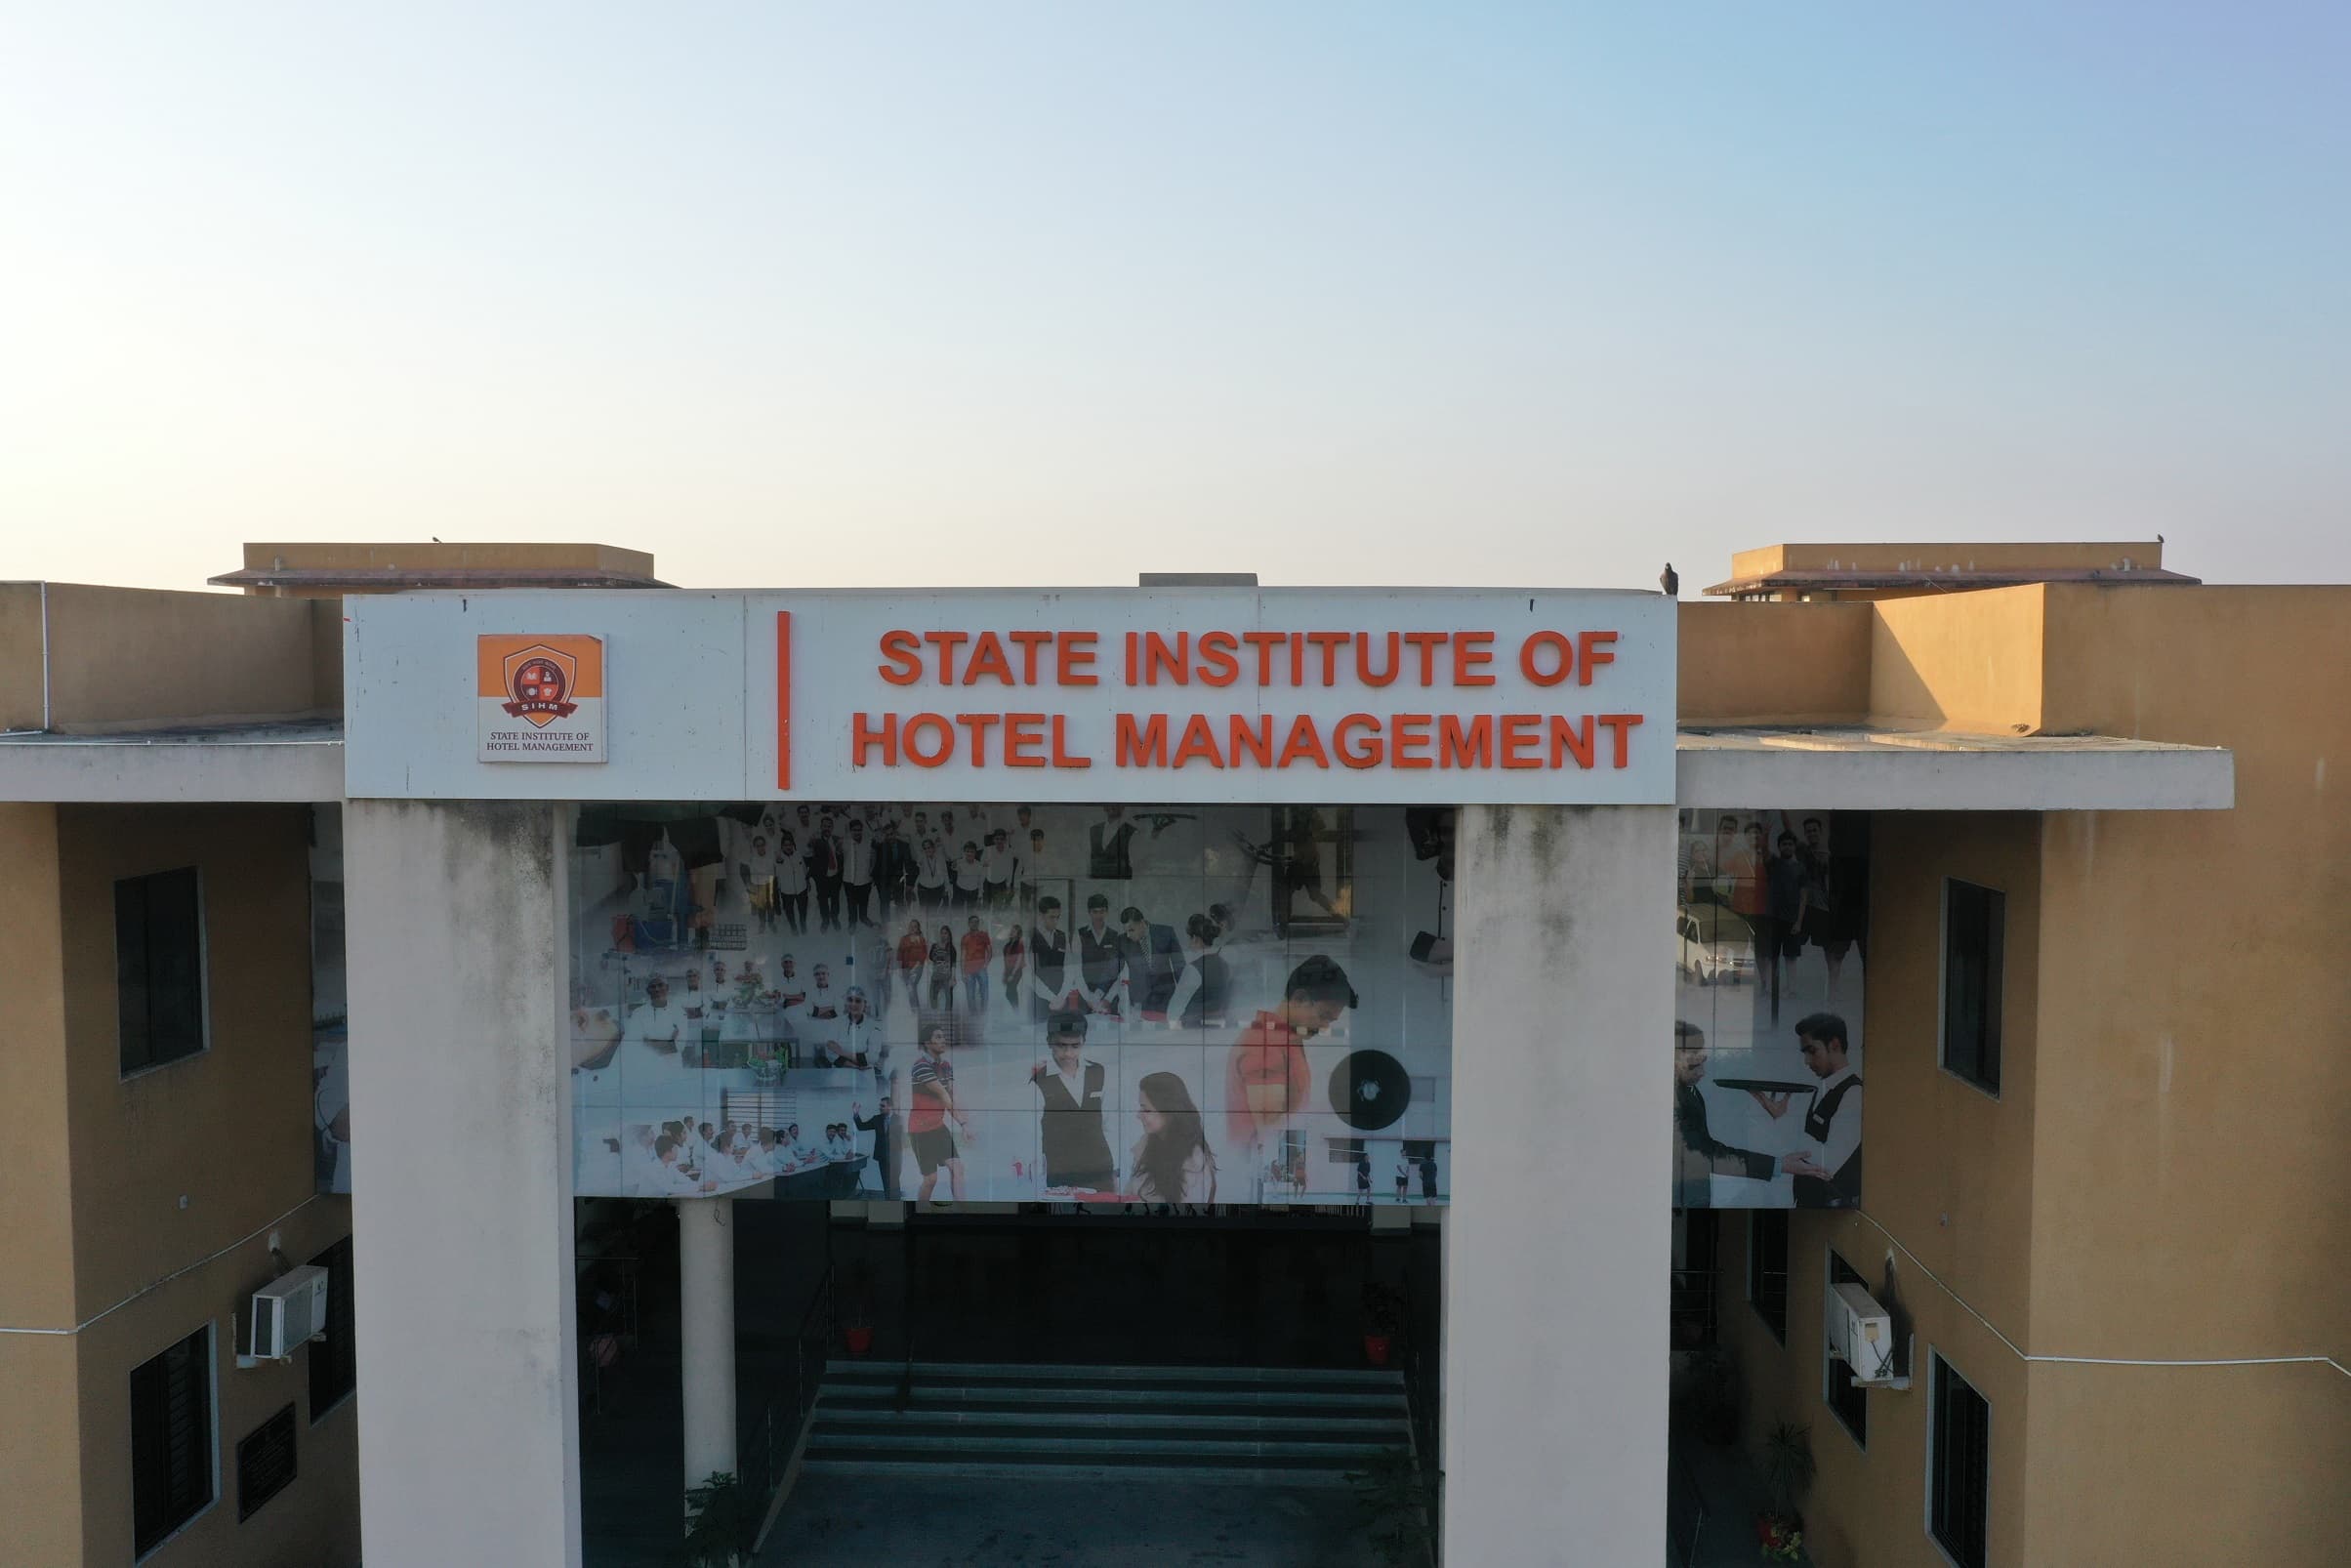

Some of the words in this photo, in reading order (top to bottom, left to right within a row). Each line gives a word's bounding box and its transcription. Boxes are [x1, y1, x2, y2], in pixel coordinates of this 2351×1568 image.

[879, 631, 1098, 686] STATE
[1126, 632, 1496, 686] INSTITUTE
[1520, 631, 1619, 686] OF
[521, 702, 558, 711] SIHM
[490, 732, 518, 741] STATE
[521, 732, 573, 741] INSTITUTE
[576, 732, 590, 741] OF
[852, 713, 1092, 767] HOTEL
[1117, 714, 1644, 769] MANAGEMENT
[522, 743, 594, 752] MANAGEMENT
